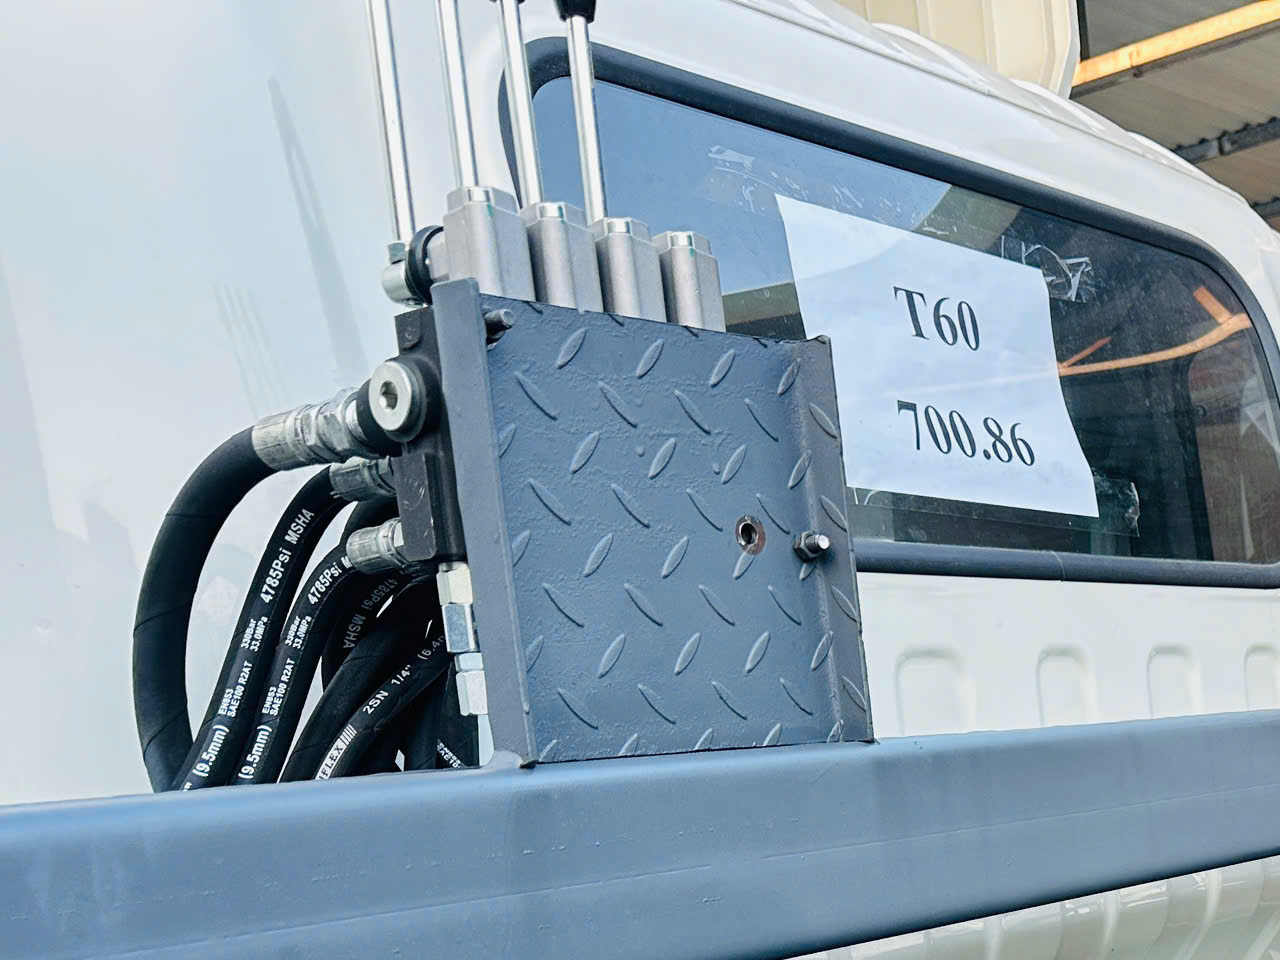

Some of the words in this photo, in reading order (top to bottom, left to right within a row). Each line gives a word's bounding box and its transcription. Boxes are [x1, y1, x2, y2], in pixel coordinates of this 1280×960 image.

[894, 286, 980, 351] T60
[897, 399, 1035, 467] 700.86
[260, 547, 292, 603] 4785Psi
[284, 508, 315, 544] MSHA
[307, 561, 343, 605] 4785Psi
[241, 618, 257, 649] 330Bar
[249, 616, 268, 652] 33.0MPa
[292, 615, 312, 649] 33.0MPa
[343, 613, 367, 649] MSHA
[218, 688, 234, 715] EN853
[226, 685, 245, 717] SAE100
[238, 660, 253, 685] R2AT
[261, 686, 277, 714] EN853
[269, 683, 287, 716] SAE100
[280, 657, 296, 682] R2AT
[363, 690, 389, 714] 2SN
[192, 724, 230, 777] (9.5mm)
[238, 725, 273, 779] (9.5mm)
